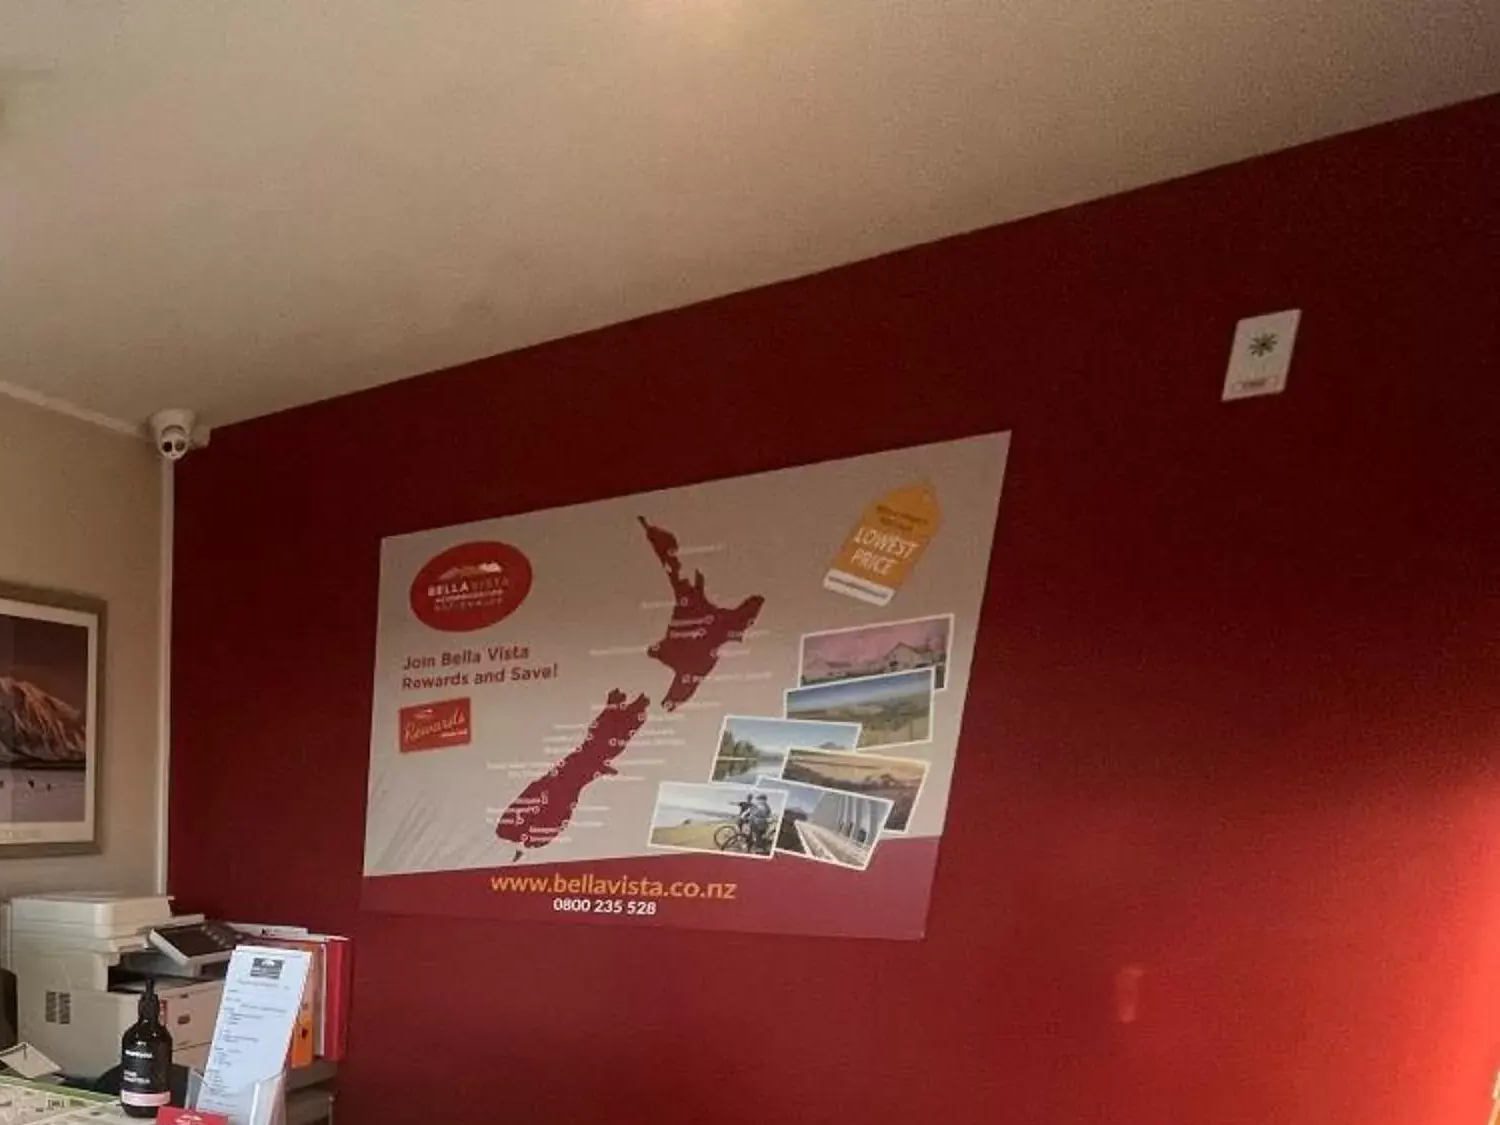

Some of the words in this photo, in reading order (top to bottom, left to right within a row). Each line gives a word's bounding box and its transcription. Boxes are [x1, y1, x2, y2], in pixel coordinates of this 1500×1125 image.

[853, 527, 920, 559] LOWEST
[850, 548, 898, 575] PRICE
[427, 580, 469, 597] BELLA
[471, 576, 510, 592] VISTA
[404, 655, 436, 671] Join
[441, 649, 482, 667] Bella
[487, 645, 530, 662] Vista
[401, 671, 469, 690] Rewards
[474, 667, 505, 686] and
[509, 662, 558, 682] Save!
[490, 872, 736, 899] www.bellavista.co.nz
[553, 898, 592, 913] 0800
[593, 899, 623, 914] 235
[627, 900, 657, 916] 528
